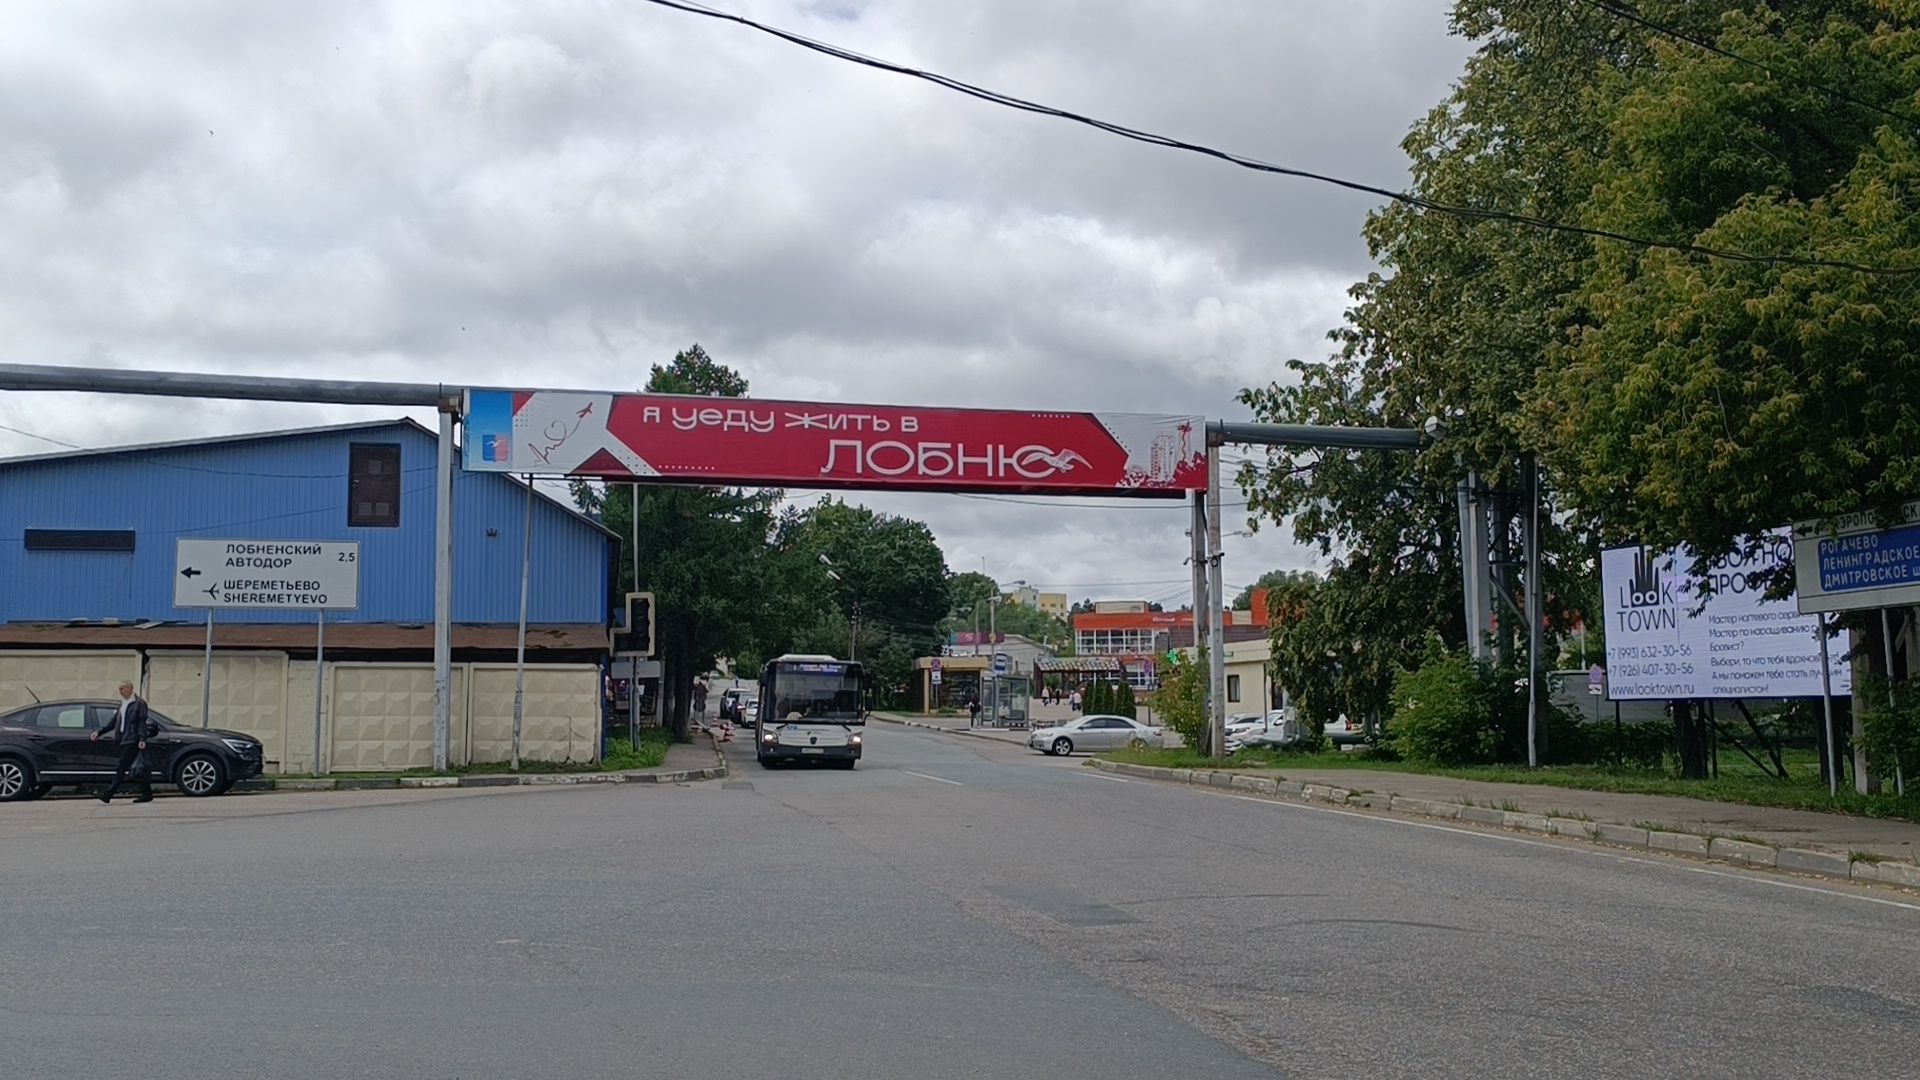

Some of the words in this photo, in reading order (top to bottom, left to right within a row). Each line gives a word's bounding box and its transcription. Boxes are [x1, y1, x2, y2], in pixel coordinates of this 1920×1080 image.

[672, 407, 775, 432] уеду
[785, 412, 891, 432] жить
[901, 416, 919, 432] в
[820, 439, 1056, 478] ЛОБНЮ
[226, 543, 322, 556] ЛОБНЕНСКИЙ
[1821, 534, 1879, 555] РОГАЧЕВО
[338, 552, 355, 563] 2,5
[1762, 540, 1793, 565] НО
[1823, 544, 1920, 571] ЛЕНИНГРАДСКОЕ
[225, 557, 292, 569] АВТОДОР
[1708, 571, 1776, 596] ПРОФ
[1825, 564, 1908, 589] ДМИТРОВСКОЕ
[223, 579, 321, 592] ШЕРЕМЕТЬЕВО
[223, 592, 328, 605] SHEREMETYEVO
[1617, 608, 1676, 633] TOWN
[1708, 614, 1738, 625] Мастер
[1739, 612, 1777, 622] ногтевого
[1709, 628, 1739, 639] Мастер
[1740, 629, 1749, 637] по
[1618, 646, 1640, 660] (993)
[1641, 644, 1693, 658] 632-30-56
[1709, 641, 1745, 653] Бровист?
[1711, 656, 1742, 668] Выбери,
[1743, 657, 1752, 666] то
[1752, 656, 1767, 665] что
[1767, 654, 1785, 664] тебя
[1619, 665, 1641, 678] (926)
[1642, 662, 1694, 677] 407-30-56
[1712, 671, 1718, 680] А
[1766, 669, 1785, 679] тебе
[1786, 668, 1808, 678] стать
[1809, 667, 1842, 680] лучим
[1611, 682, 1695, 696] www.looktown.ru
